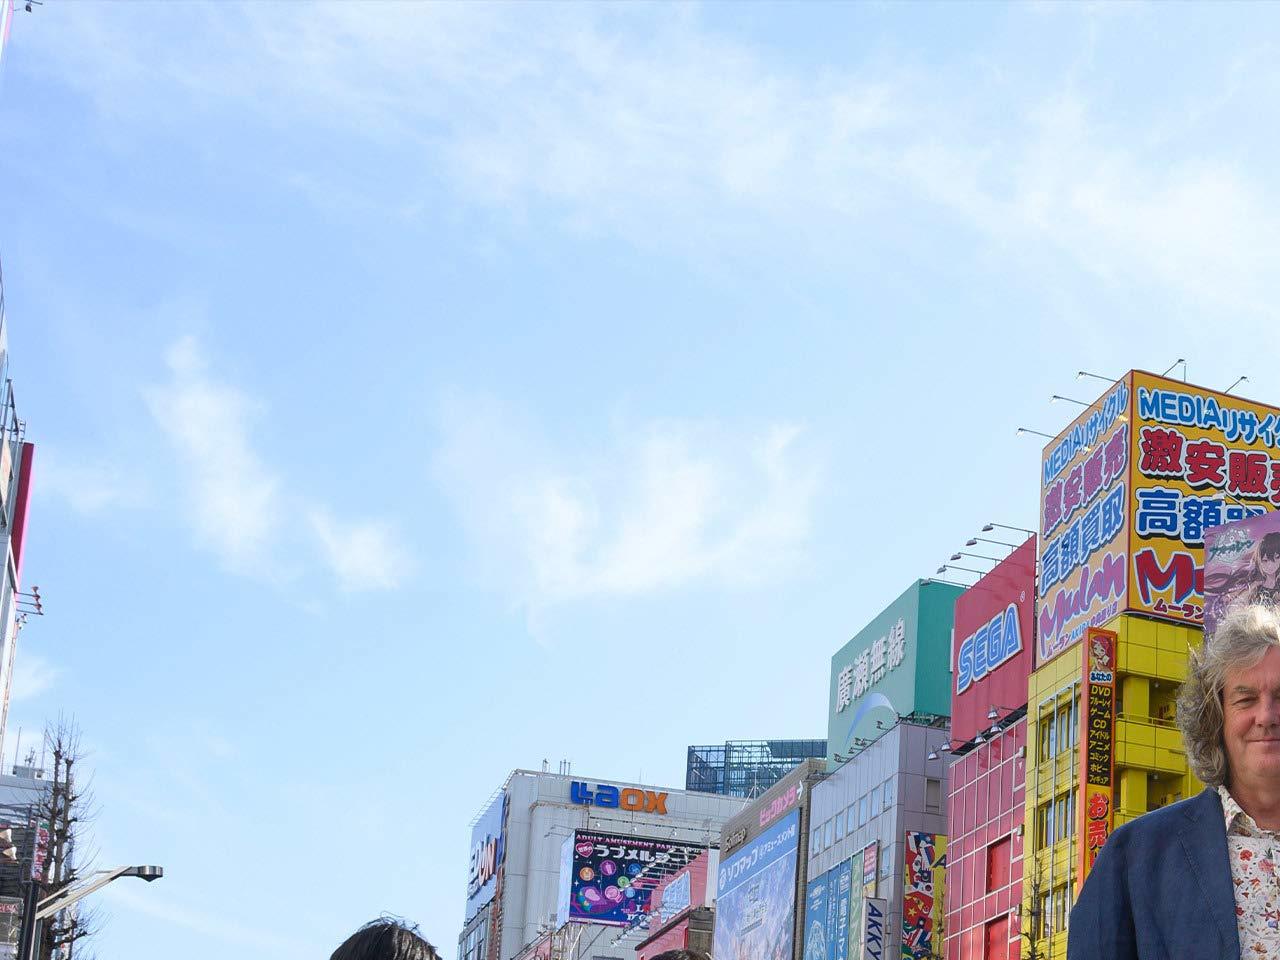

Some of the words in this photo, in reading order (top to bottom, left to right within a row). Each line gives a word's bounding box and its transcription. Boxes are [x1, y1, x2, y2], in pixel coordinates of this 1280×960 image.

[957, 603, 1023, 695] SEGA
[1091, 685, 1111, 696] DVD
[1090, 708, 1111, 719] ゲーム
[1093, 719, 1107, 729] CD
[1089, 740, 1110, 751] アニメ
